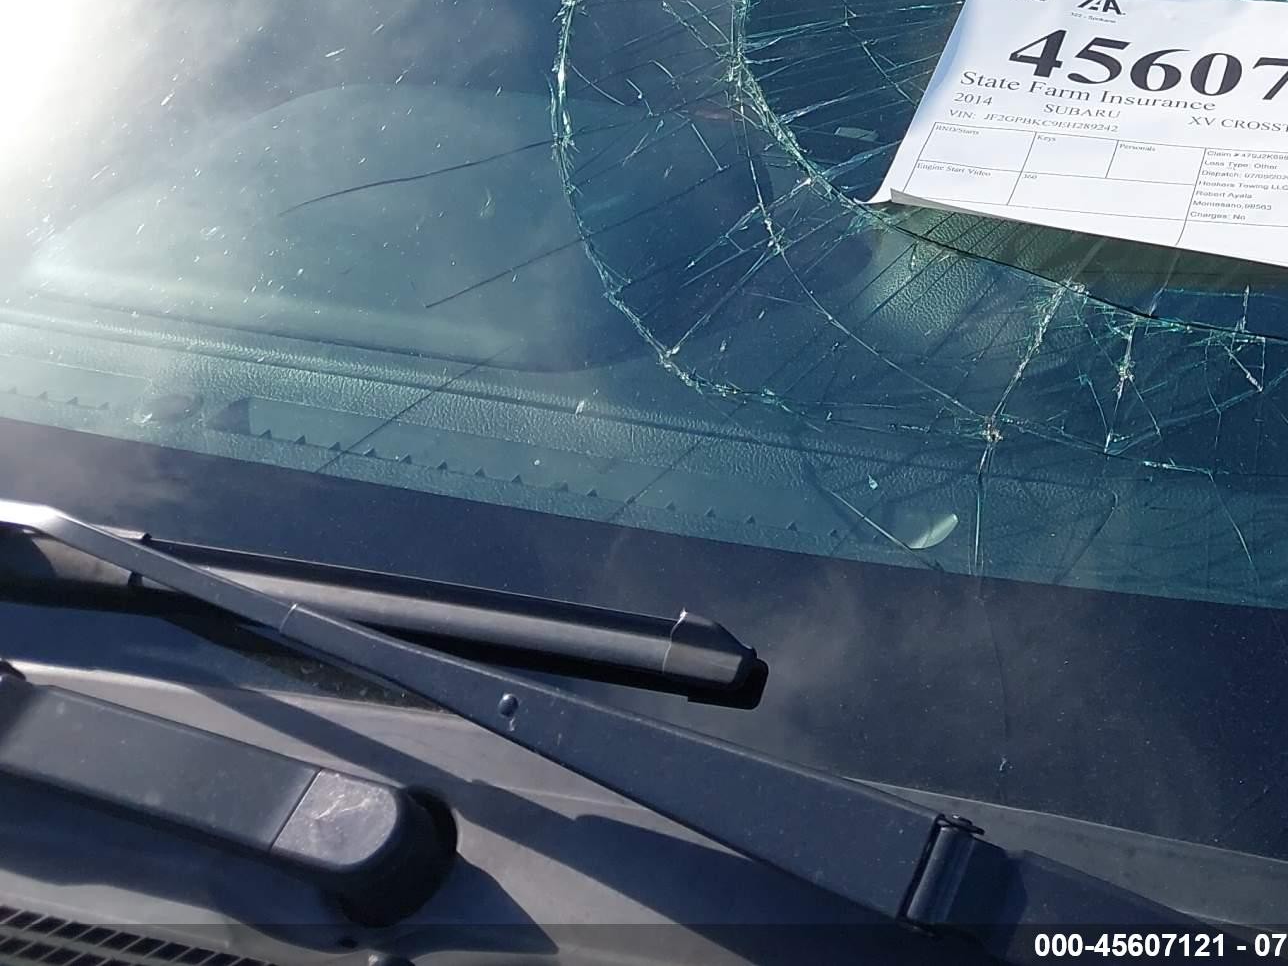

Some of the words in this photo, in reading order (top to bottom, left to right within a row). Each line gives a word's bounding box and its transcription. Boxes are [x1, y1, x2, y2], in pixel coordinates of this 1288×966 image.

[960, 70, 1020, 91] State
[1029, 81, 1091, 101] Farm
[1100, 90, 1217, 111] Insurance
[953, 92, 993, 106] 2014
[1043, 103, 1121, 119] SUBARU
[1188, 116, 1216, 126] XV
[949, 109, 977, 120] VIN:
[1037, 134, 1057, 142] Keys
[1119, 143, 1156, 152] Personals
[917, 162, 945, 171] Engine
[946, 164, 965, 173] Start
[968, 168, 992, 177] Video
[1254, 162, 1278, 170] Other
[1201, 169, 1241, 178] Dispatch:
[1238, 182, 1269, 191] Towing
[1195, 190, 1226, 198] Robert
[1227, 192, 1253, 200] Ayala
[1190, 211, 1229, 220] Charges:
